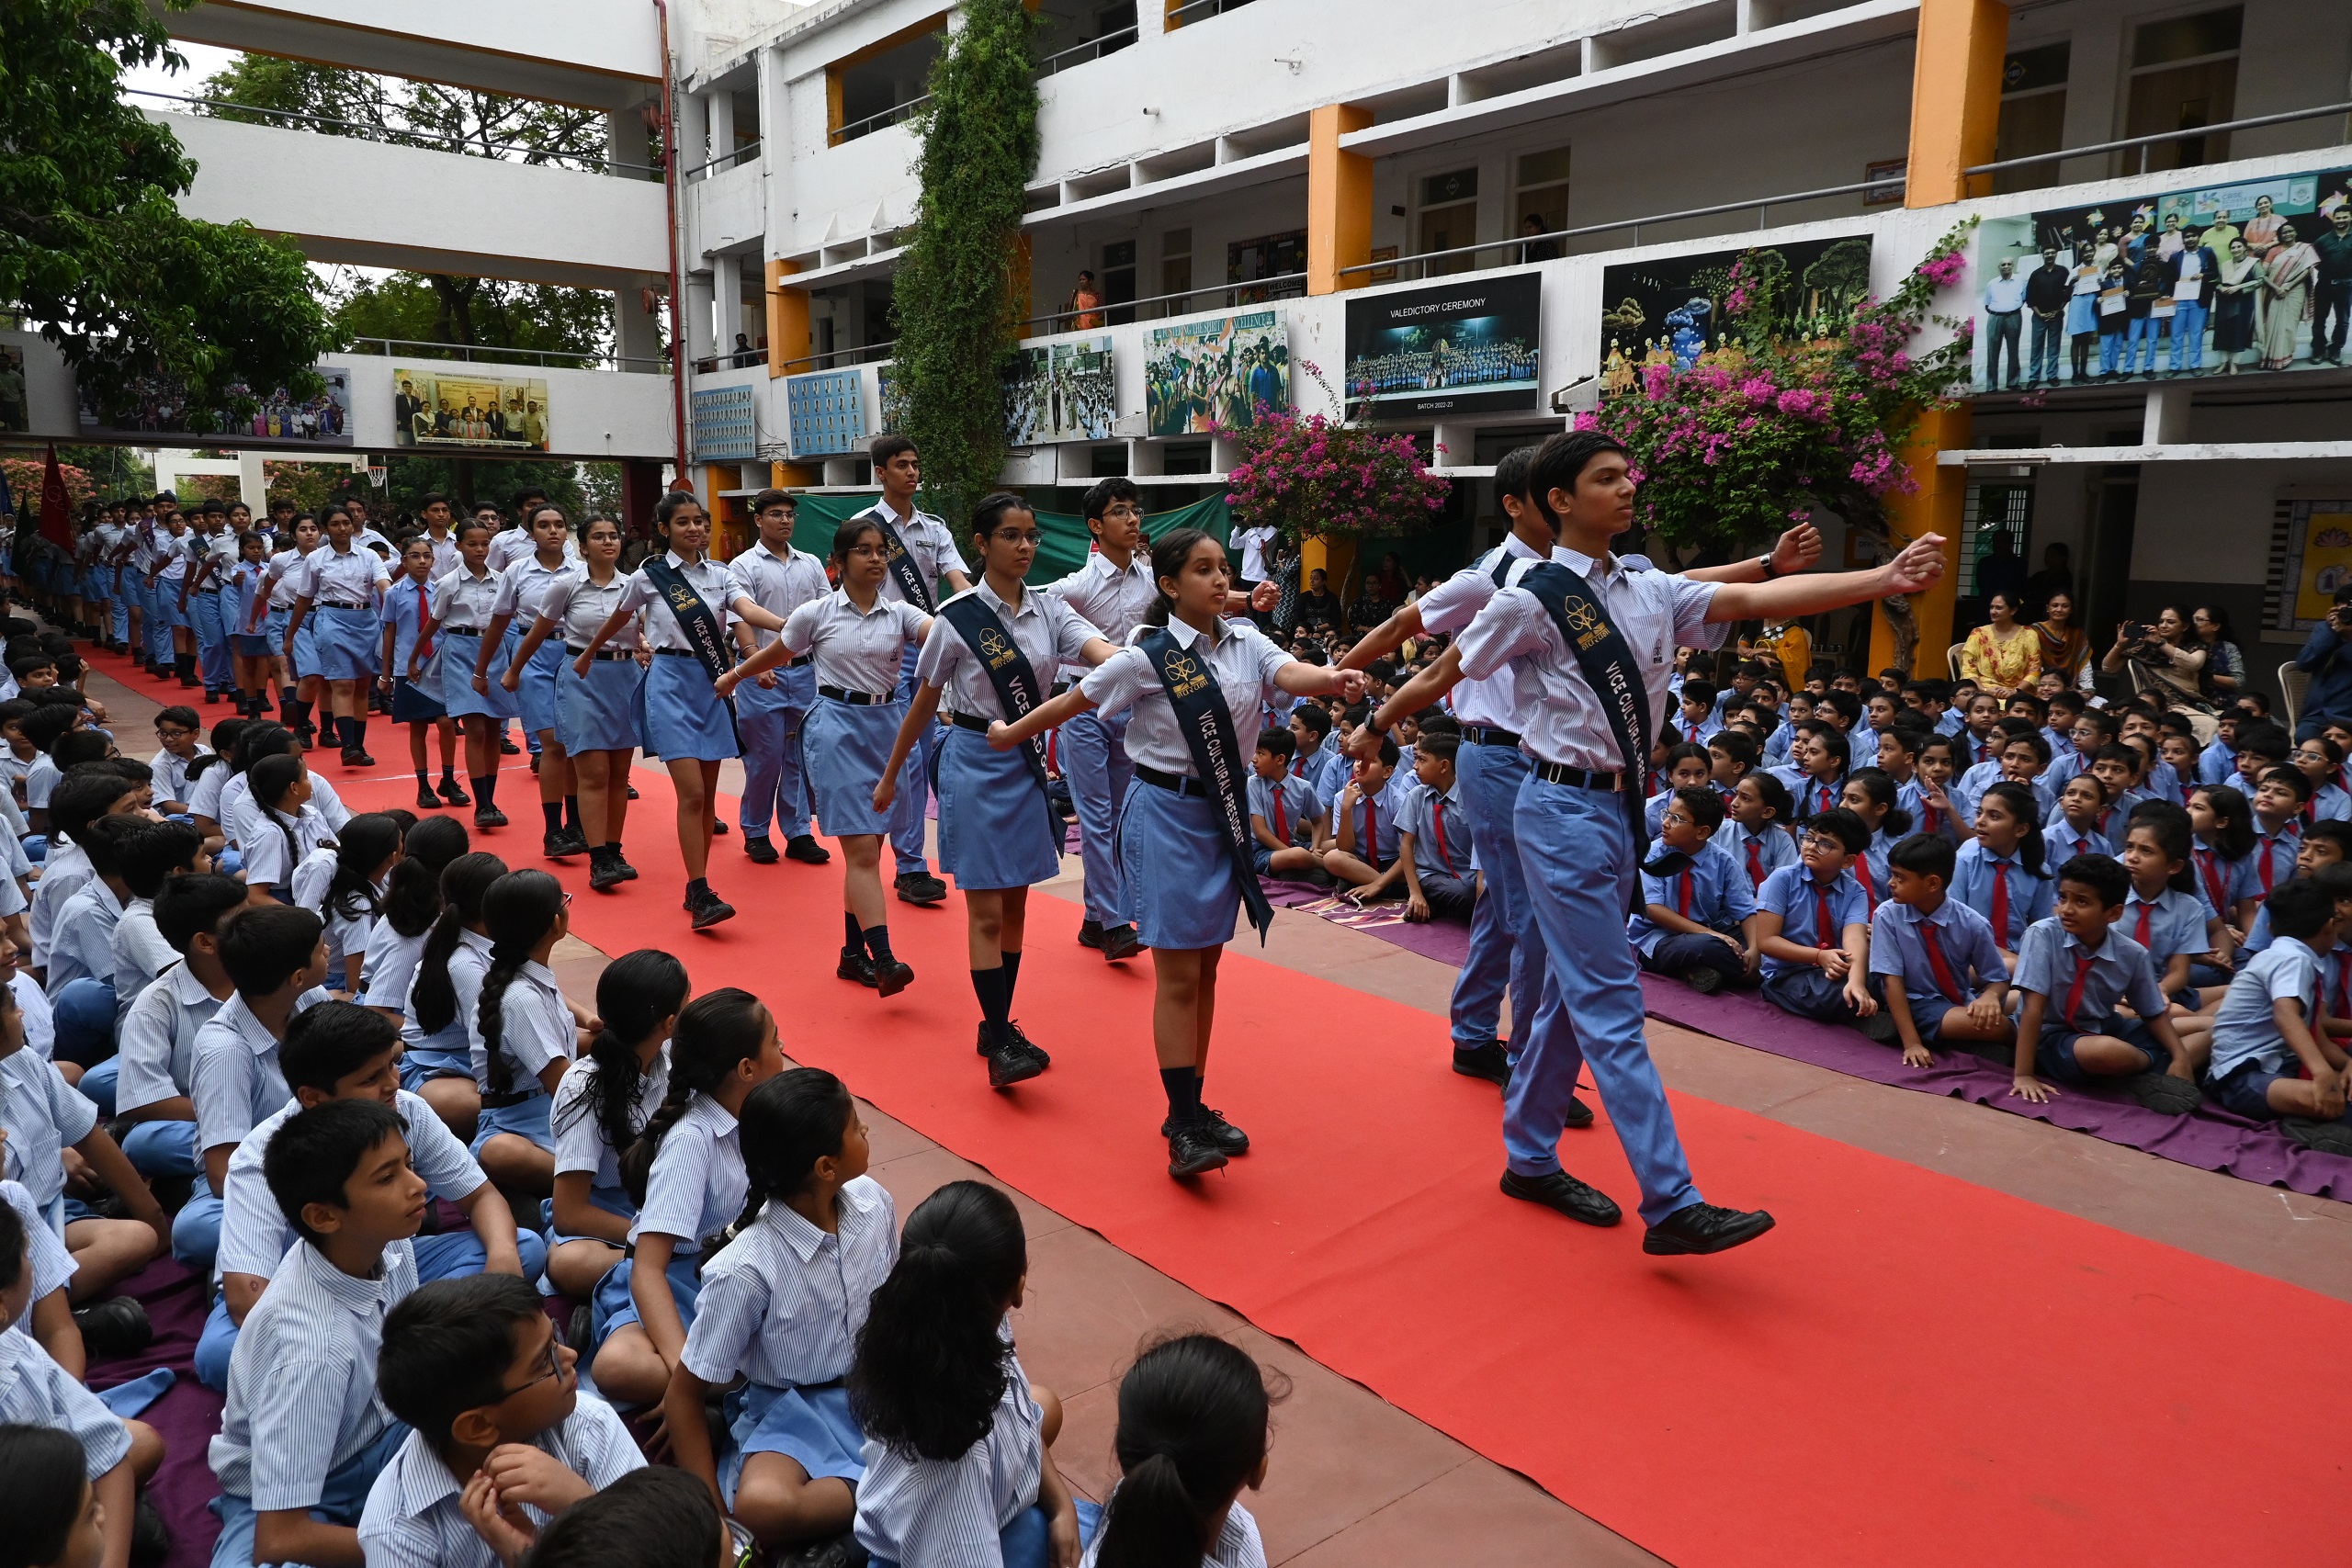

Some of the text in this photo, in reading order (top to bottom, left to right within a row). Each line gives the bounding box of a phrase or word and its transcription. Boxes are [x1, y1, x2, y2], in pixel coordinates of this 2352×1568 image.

[1269, 279, 1302, 291] WELCOME
[1390, 298, 1487, 319] VALEDICTORY CEREMONY
[1192, 324, 1204, 334] THE
[1204, 321, 1220, 333] SPIRIT
[1233, 313, 1266, 329] XCELLENCE
[1434, 400, 1453, 409] 2022-23
[900, 564, 915, 585] VICE
[693, 615, 708, 637] VICE
[702, 636, 721, 669] SPORTS
[1008, 674, 1043, 754] VICE AD
[1605, 660, 1628, 694] VICE
[1619, 692, 1643, 756] CULTURAL
[1198, 708, 1245, 847] VICE CULTURAL PRESIDENT
